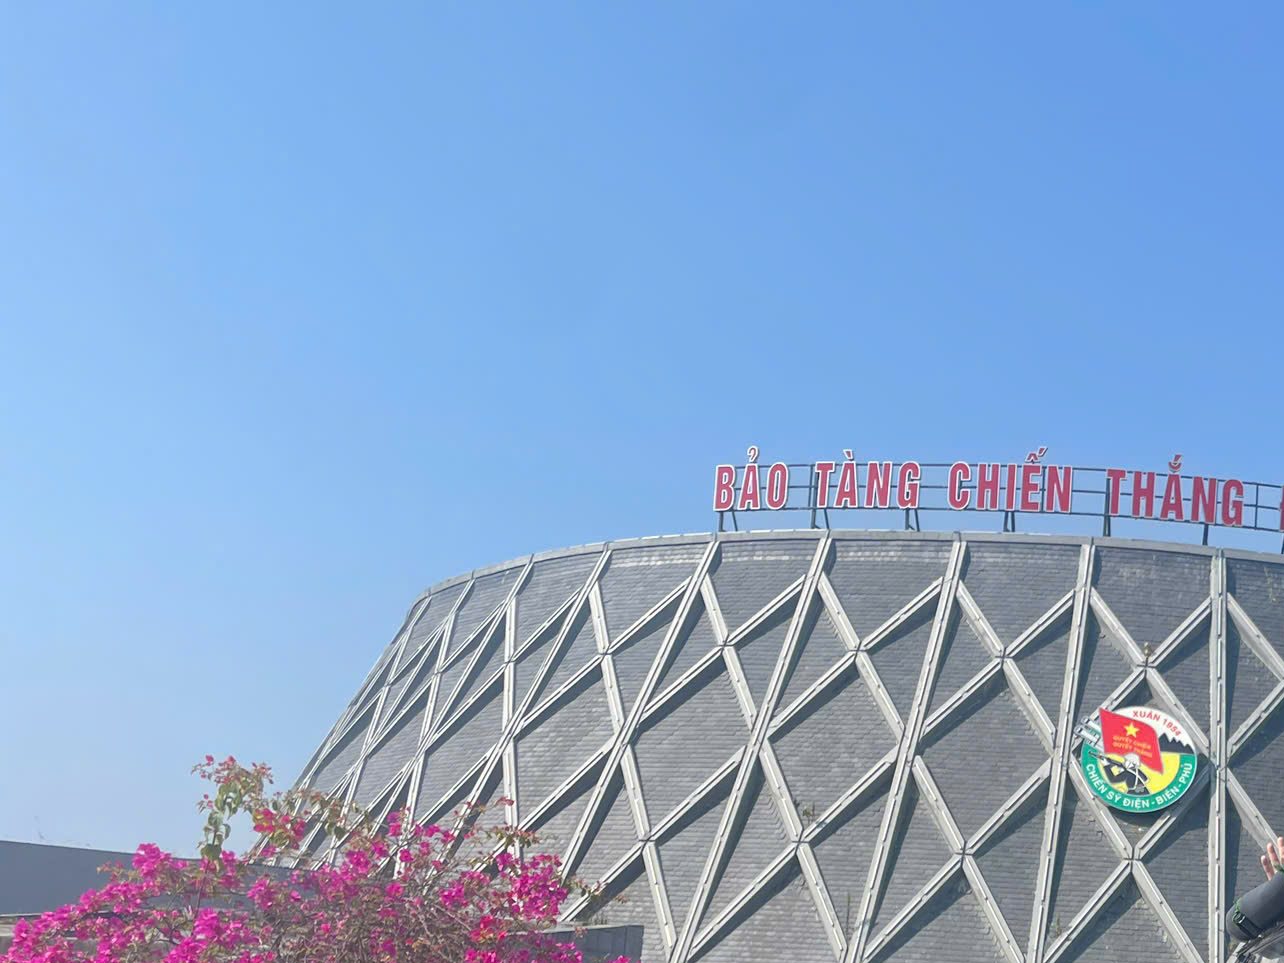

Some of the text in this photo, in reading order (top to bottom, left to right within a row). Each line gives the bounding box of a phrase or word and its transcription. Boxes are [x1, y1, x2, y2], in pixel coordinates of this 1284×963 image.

[713, 446, 789, 511] BẢO
[815, 449, 920, 510] TÀNG
[948, 446, 1073, 514] CHIẾN
[1105, 453, 1245, 527] THẮNG
[1162, 718, 1182, 736] 1954
